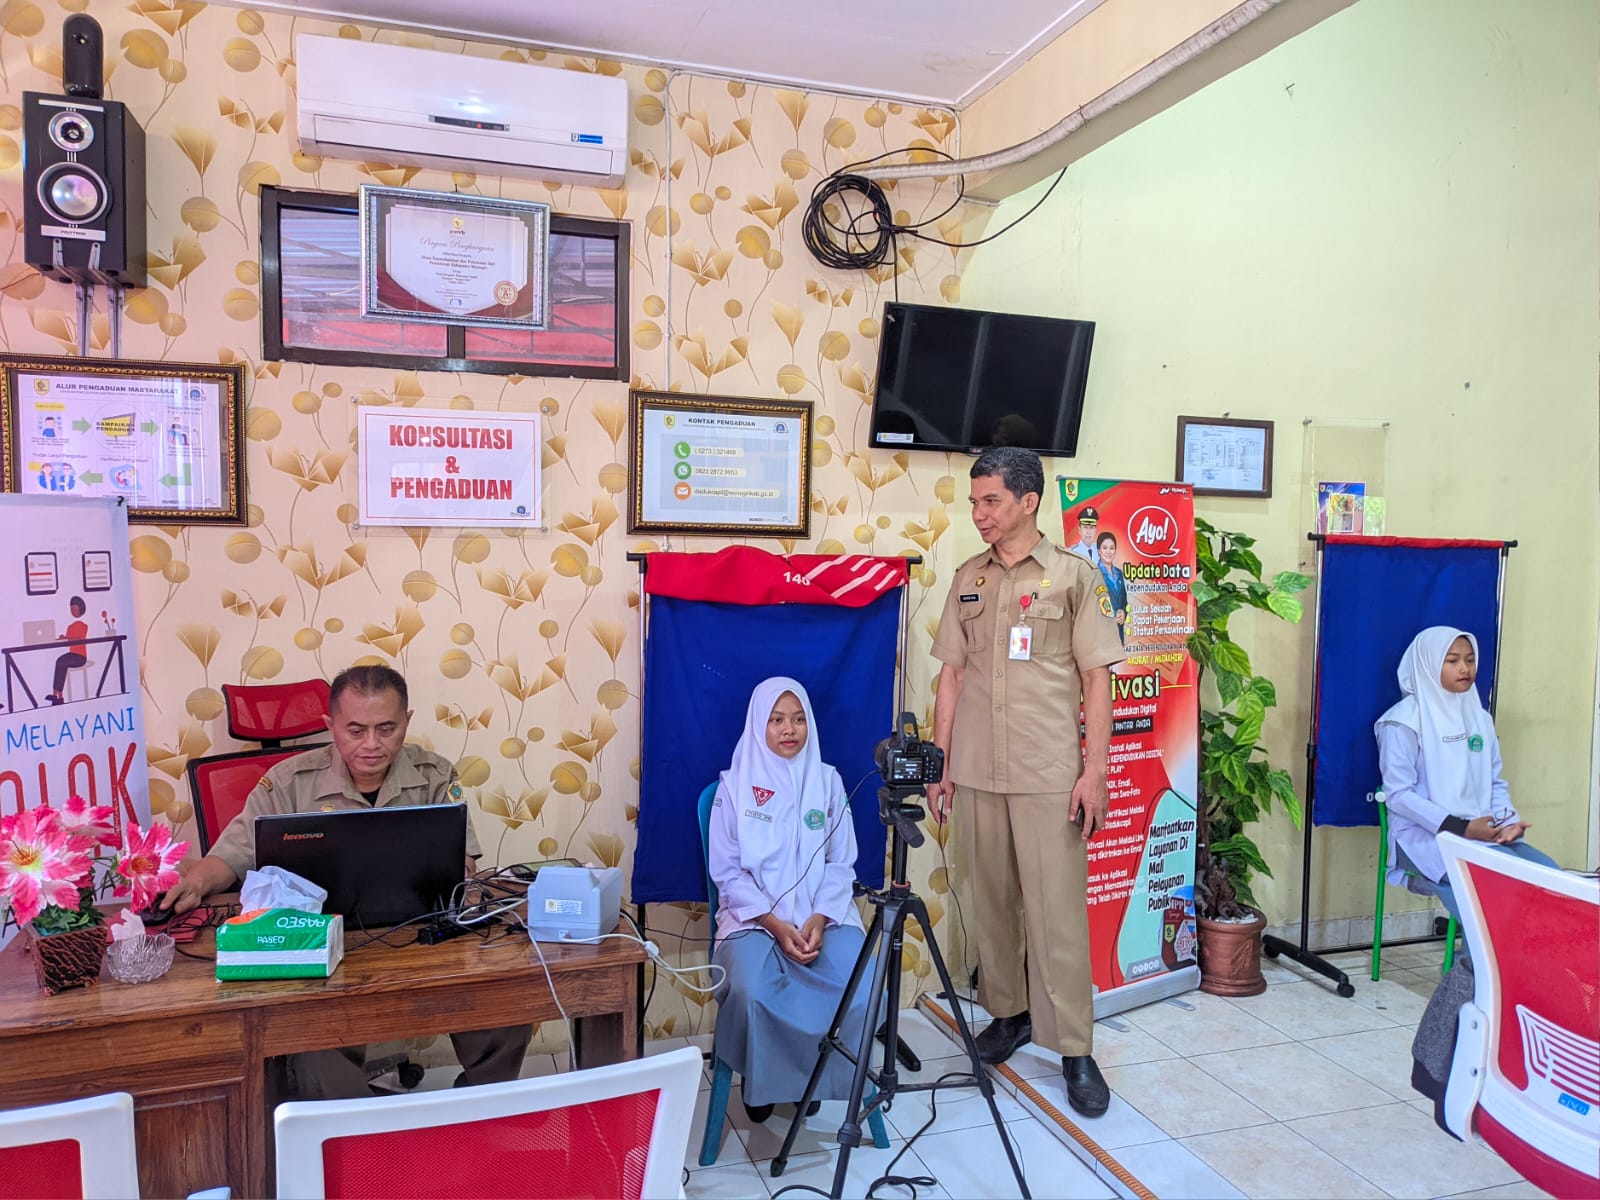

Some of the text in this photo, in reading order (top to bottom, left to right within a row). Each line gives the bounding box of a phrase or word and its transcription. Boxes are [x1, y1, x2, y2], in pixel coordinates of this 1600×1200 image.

[78, 384, 126, 392] PENGADUAN
[688, 417, 756, 427] KONTAK PENGADUAN
[389, 424, 513, 450] KONSULTASI
[445, 456, 460, 474] &
[390, 477, 513, 500] PENGADUAN
[1136, 516, 1169, 545] Ayo!
[1123, 562, 1191, 582] Update Data
[1126, 581, 1188, 592] Kependudukan Anda
[1150, 603, 1172, 613] Sekolah
[1133, 613, 1186, 625] Dapat Pekerjaan
[1133, 623, 1195, 636] Status Perkawinan
[1127, 655, 1149, 665] AKURAT
[1110, 669, 1160, 702] ivasi
[1112, 703, 1157, 717] ndudukan Digital
[7, 707, 135, 754] MELAYANI
[1115, 718, 1151, 732] PINTAR ANDA
[1125, 741, 1142, 752] Aplikasi
[1109, 791, 1119, 800] dan
[1149, 818, 1196, 840] Manfaatkan
[283, 831, 325, 841] lenovo
[1087, 839, 1105, 850] ktivasi
[1148, 836, 1189, 858] Layanan Di
[1087, 852, 1097, 862] ang
[1148, 859, 1165, 876] Mall
[1087, 872, 1101, 882] asuk
[1087, 885, 1104, 895] engan
[1148, 874, 1185, 895] Pelayanan
[1087, 896, 1097, 905] ang
[1147, 893, 1171, 913] Publik
[276, 916, 326, 929] PASEO
[257, 935, 286, 944] PASEO
